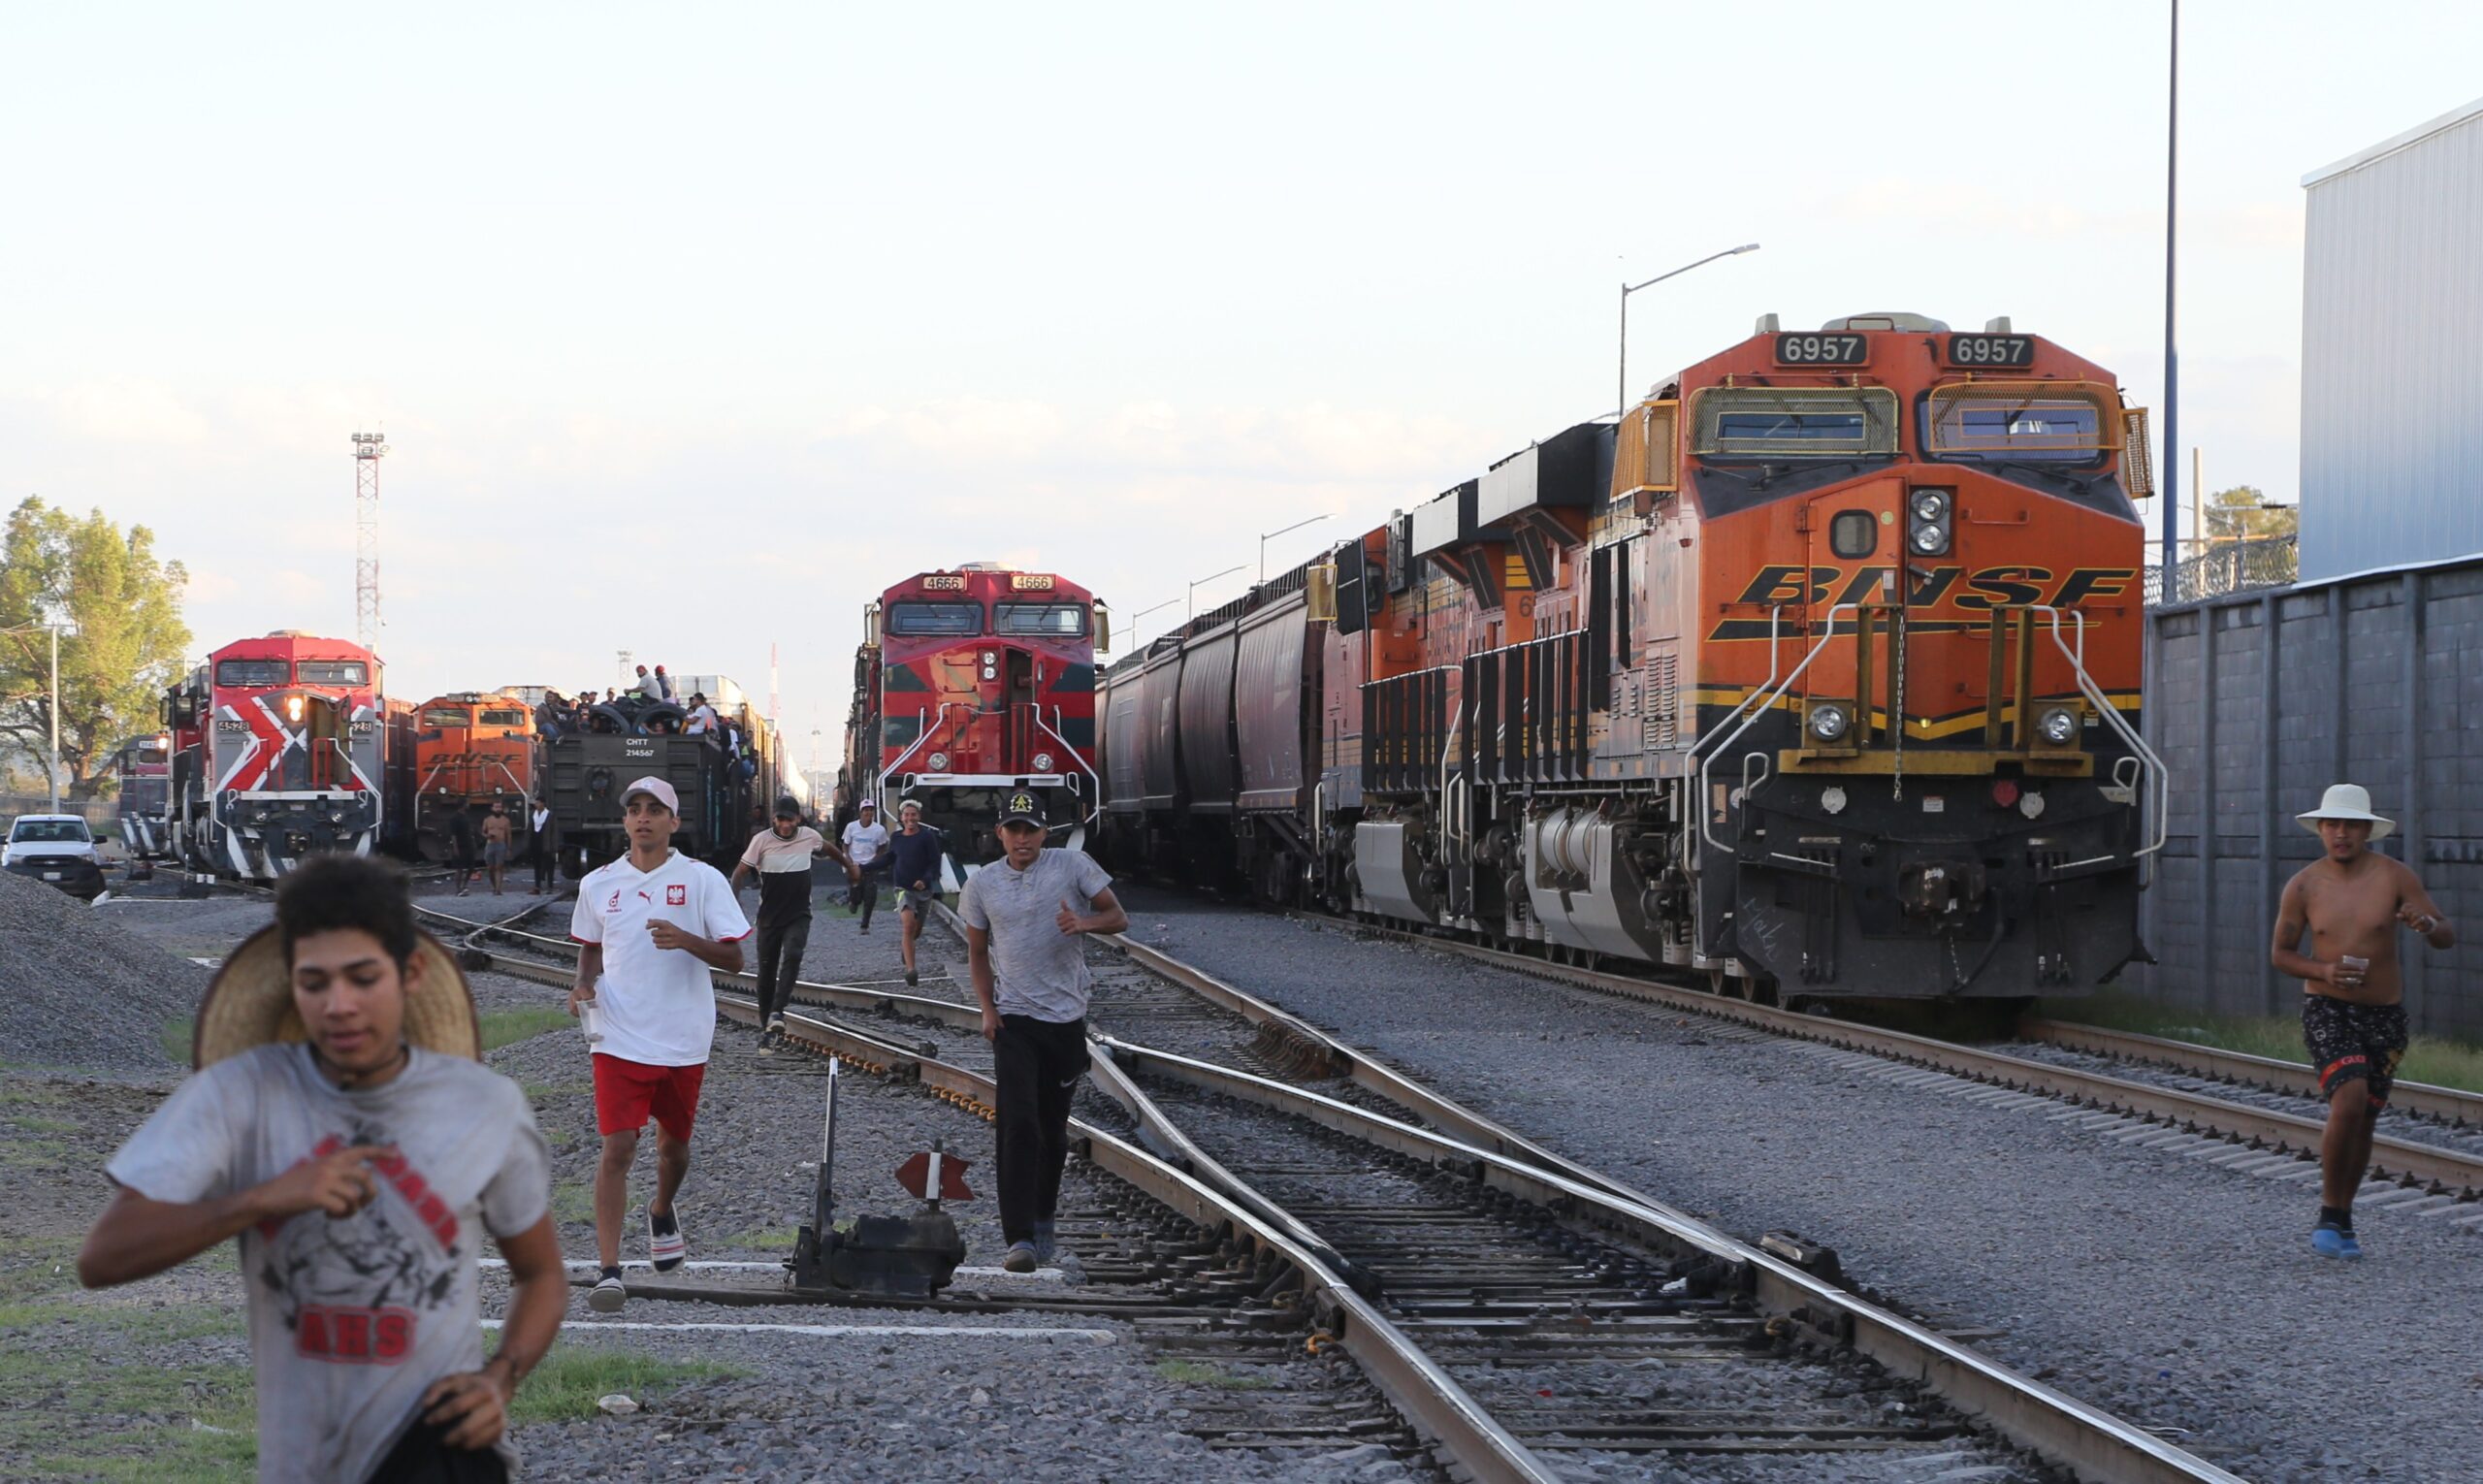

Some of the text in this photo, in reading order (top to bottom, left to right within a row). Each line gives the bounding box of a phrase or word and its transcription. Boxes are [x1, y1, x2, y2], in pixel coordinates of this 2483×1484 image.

[1784, 337, 1858, 362] 6957
[1956, 338, 2026, 363] 6957
[927, 577, 959, 590] 4666
[1016, 576, 1048, 589] 4666
[1736, 565, 2139, 611] BNSF
[218, 721, 250, 731] 4528
[430, 753, 523, 764] BNSF
[301, 1311, 407, 1358] AHS
